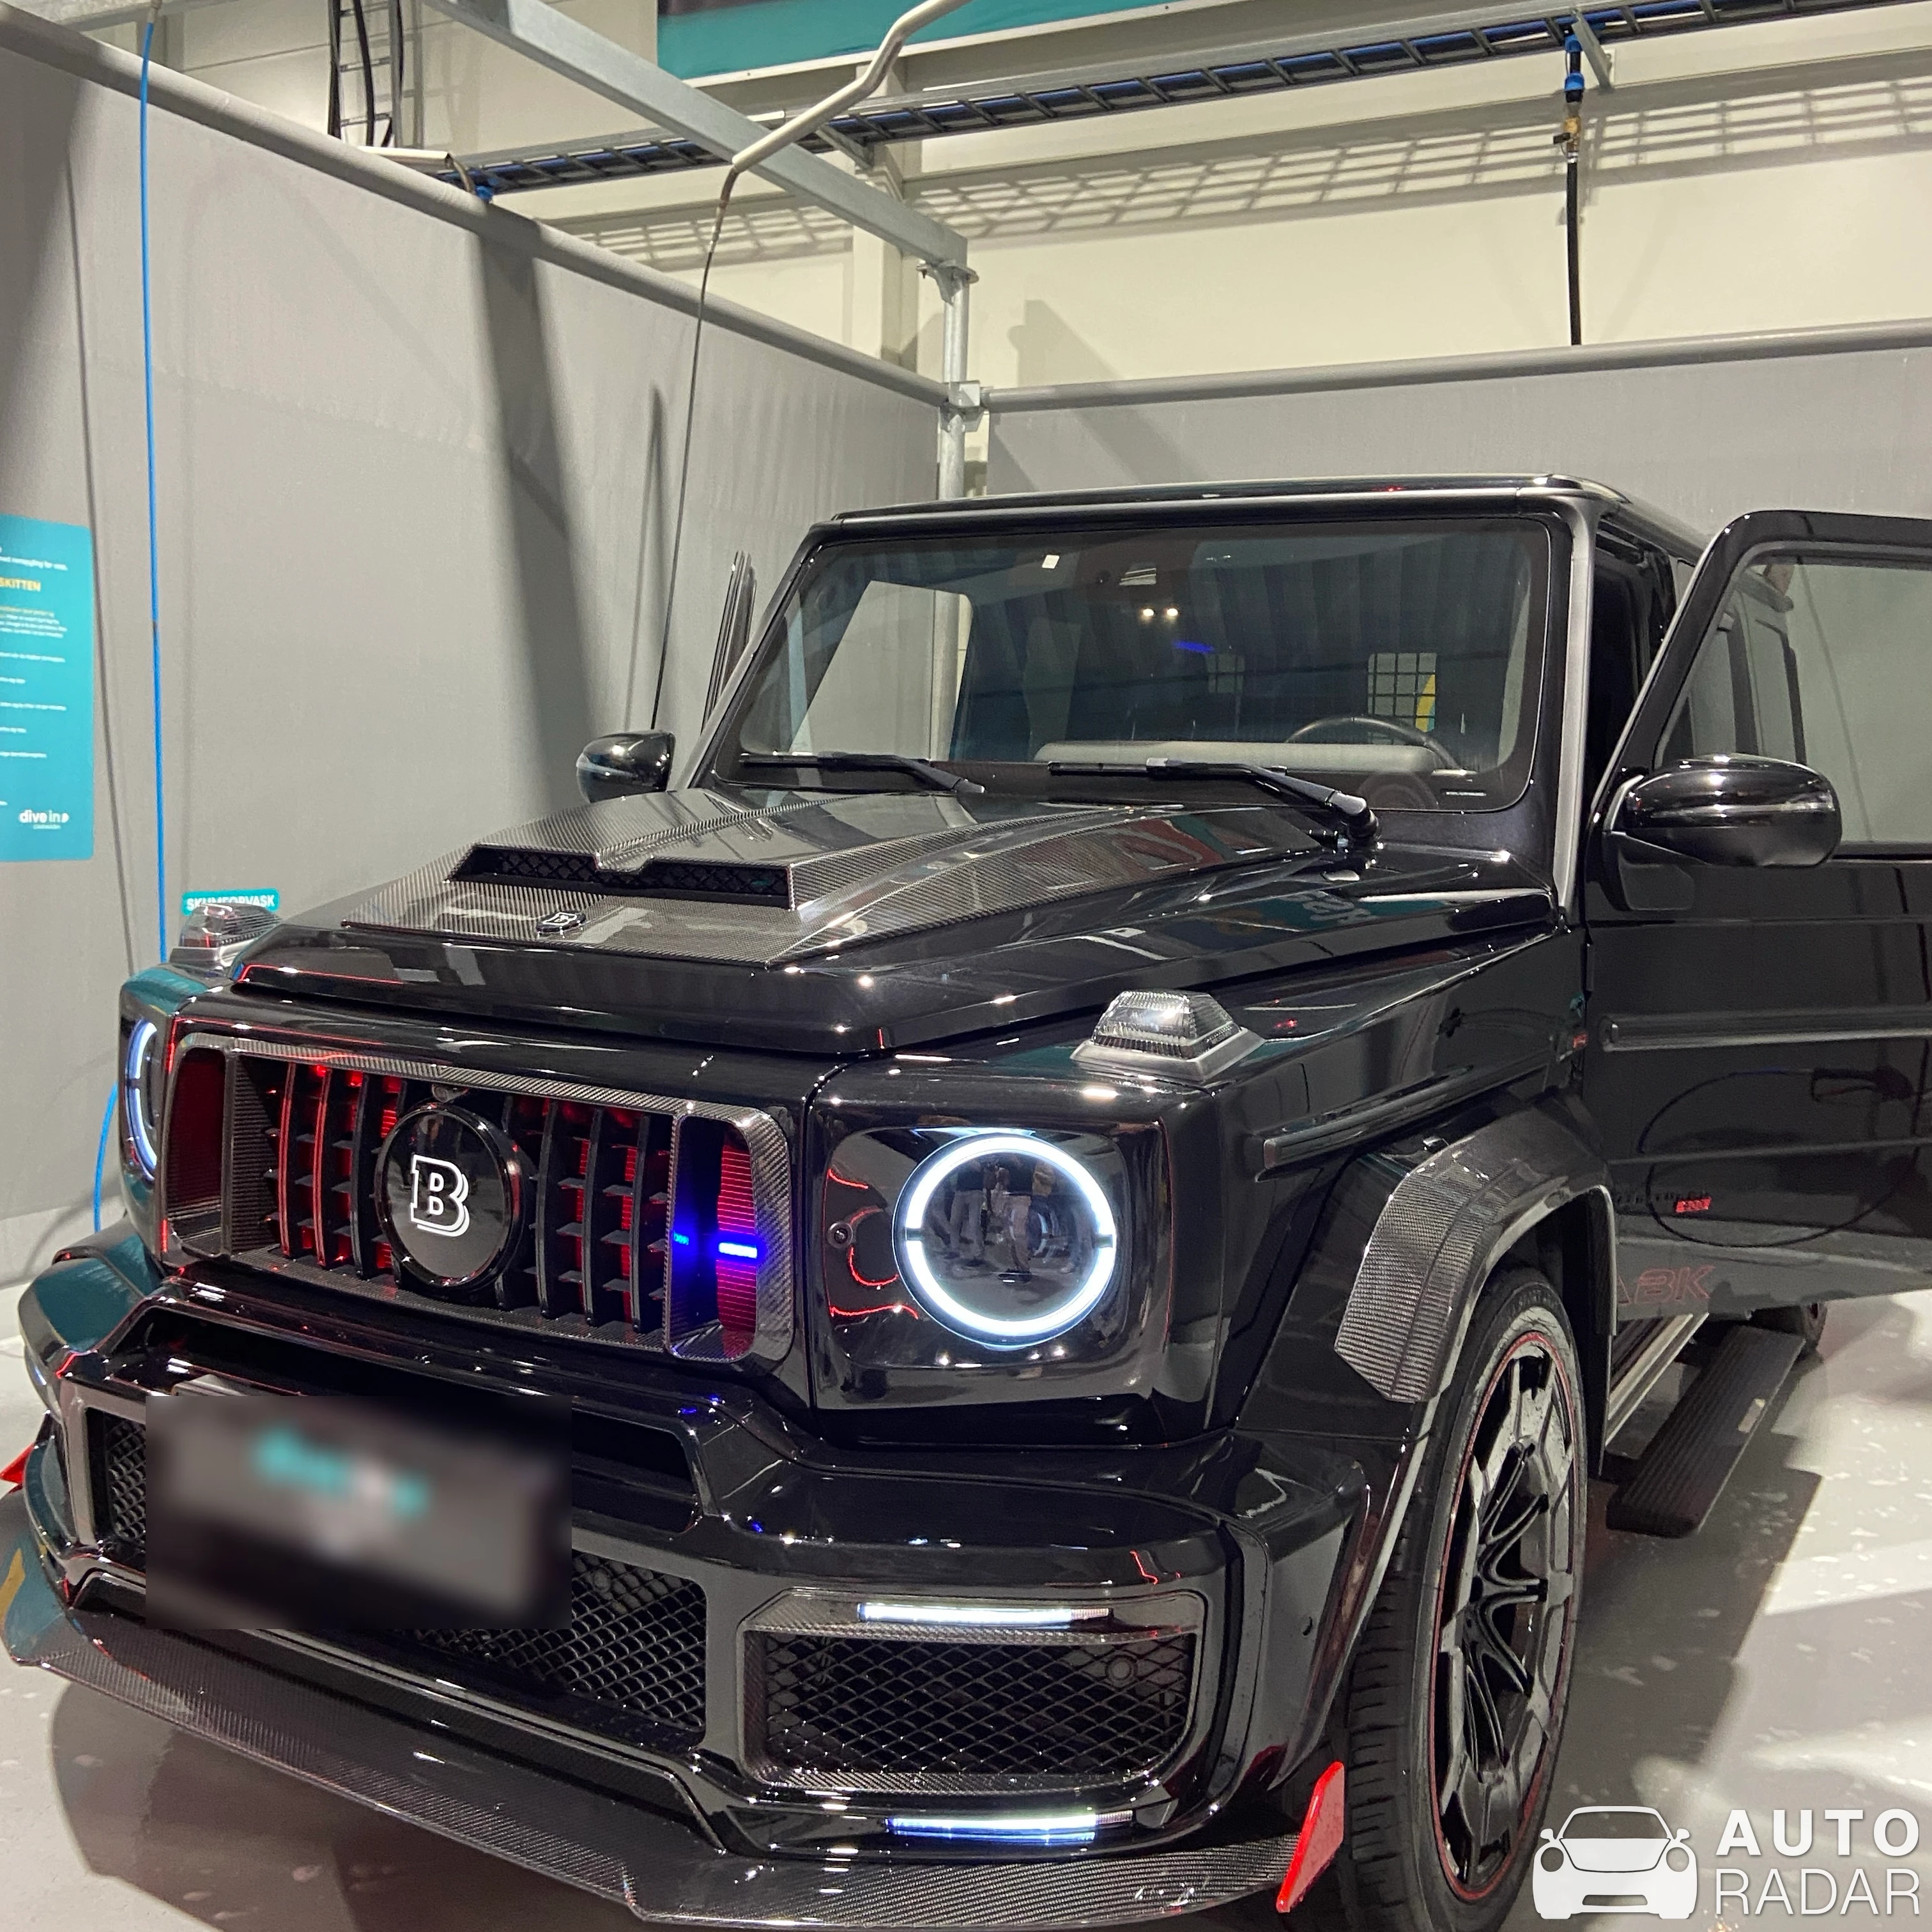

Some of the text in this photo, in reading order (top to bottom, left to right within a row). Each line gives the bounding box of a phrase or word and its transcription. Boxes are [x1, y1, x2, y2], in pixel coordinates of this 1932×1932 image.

[19, 809, 61, 823] dive in
[410, 1154, 470, 1237] B
